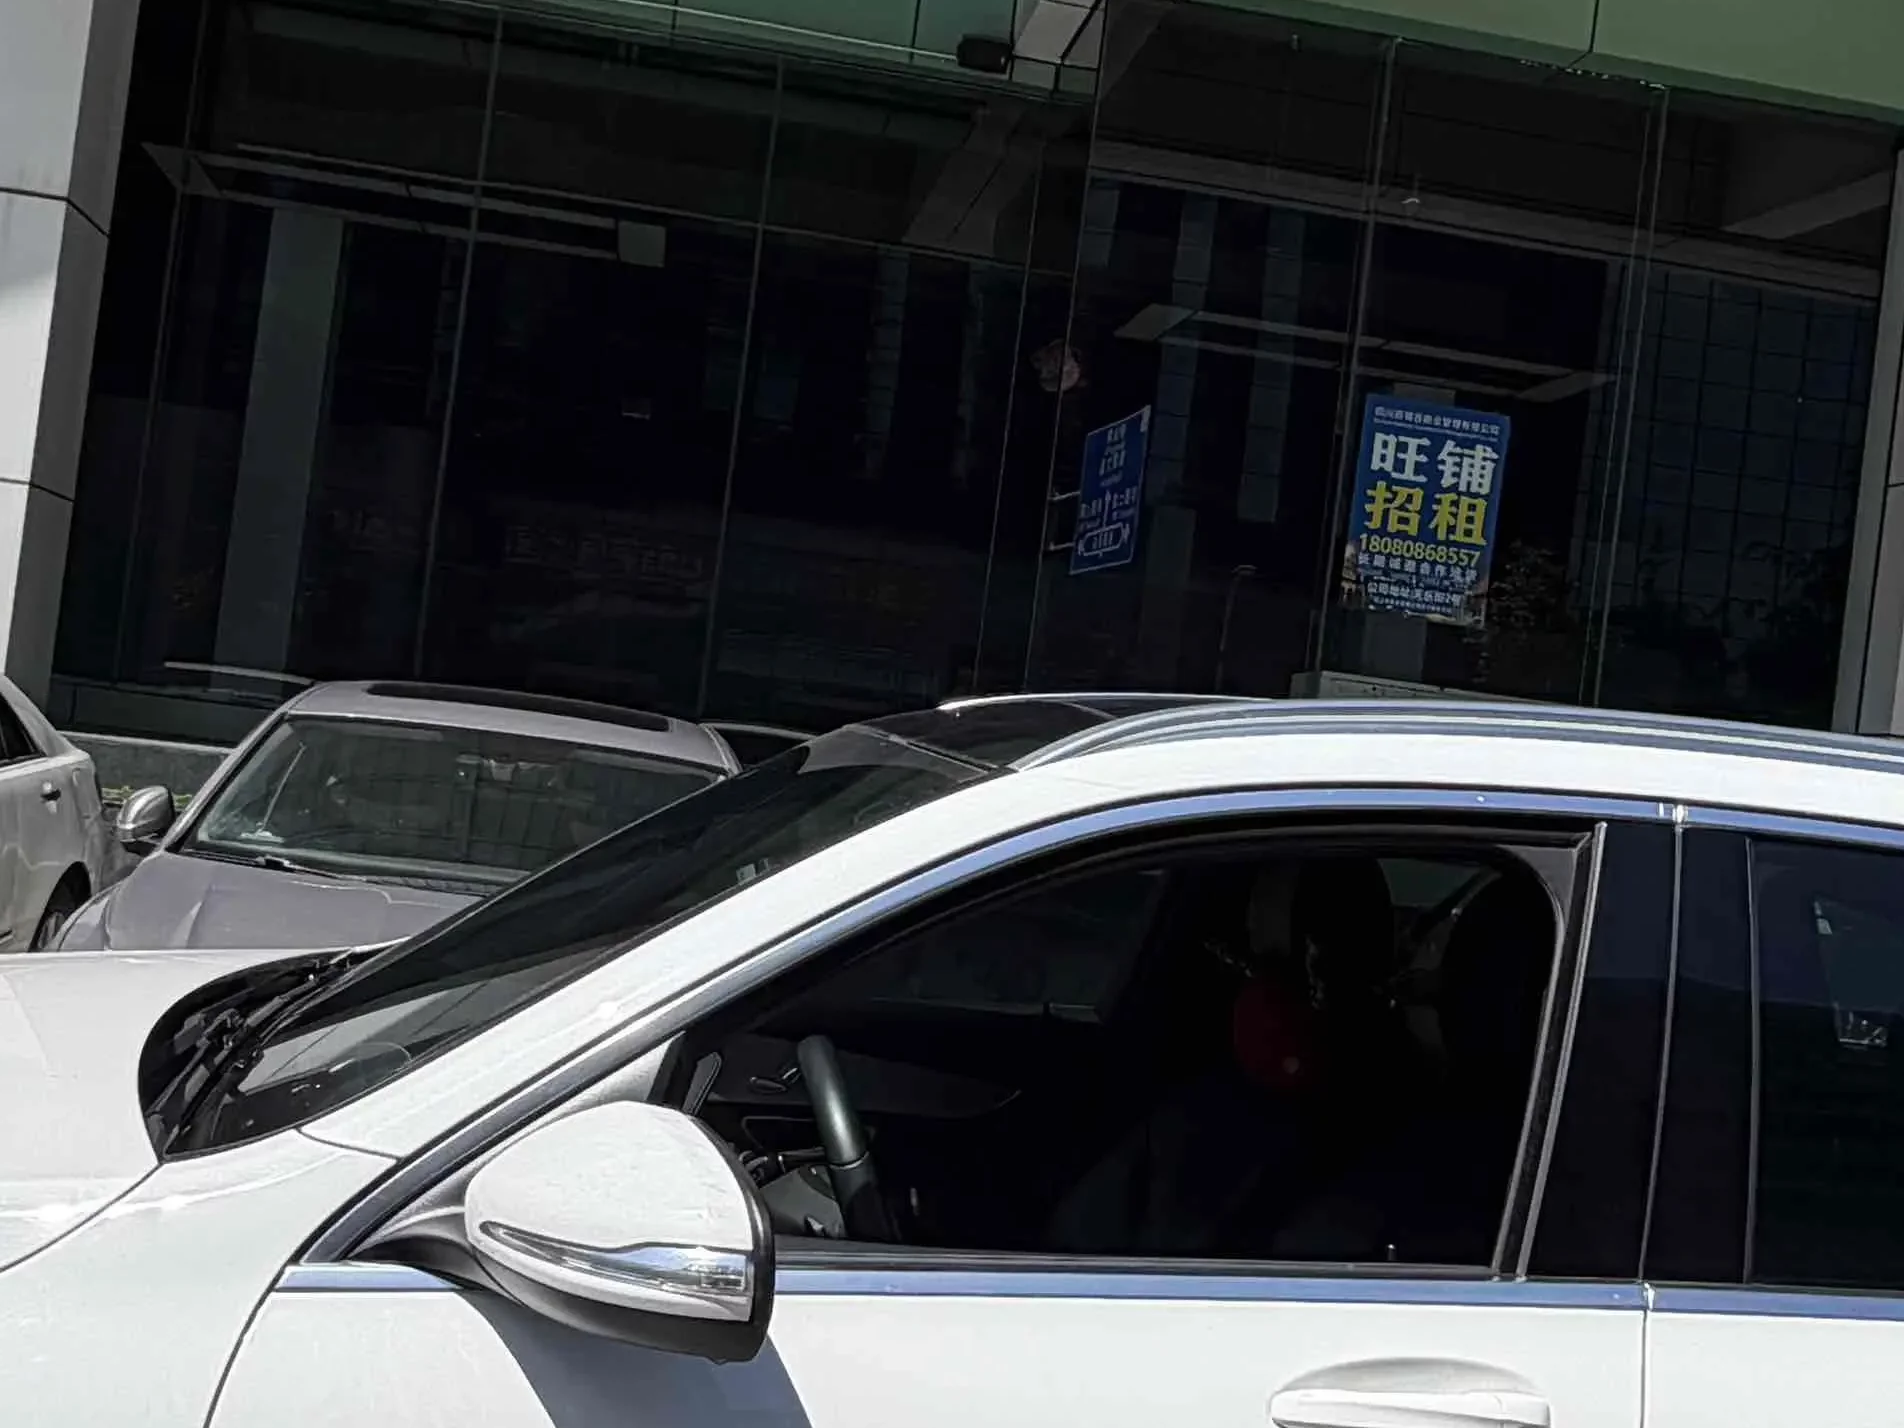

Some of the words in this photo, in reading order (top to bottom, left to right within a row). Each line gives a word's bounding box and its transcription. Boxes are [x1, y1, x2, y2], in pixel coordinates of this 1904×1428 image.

[1370, 432, 1499, 495] 旺铺
[1364, 480, 1487, 546] 招租
[1359, 533, 1480, 566] 18080868557
